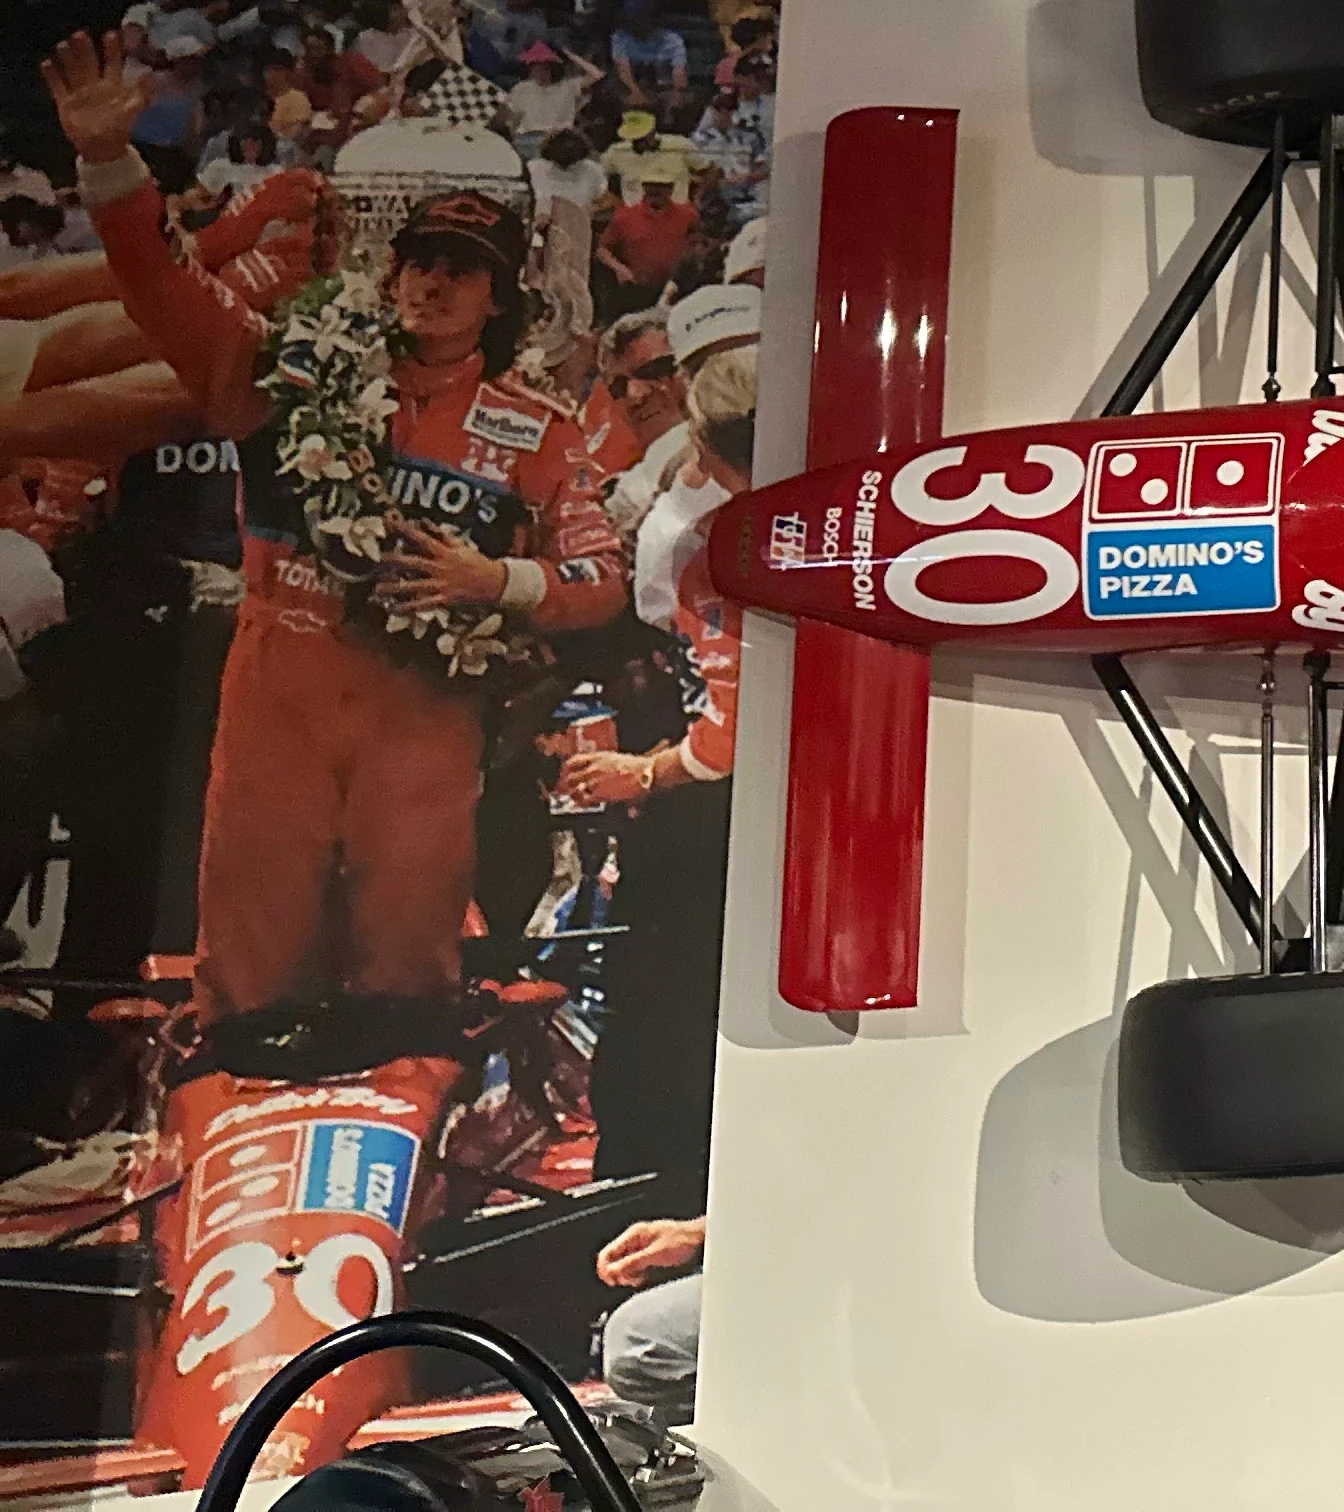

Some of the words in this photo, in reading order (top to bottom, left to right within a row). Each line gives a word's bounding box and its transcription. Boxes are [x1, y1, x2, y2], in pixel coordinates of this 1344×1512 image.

[851, 469, 883, 611] SCHIERSON
[884, 444, 1086, 626] 30
[1098, 540, 1266, 571] DOMINO'S
[1098, 573, 1199, 600] PIZZA
[176, 1233, 395, 1376] 30
